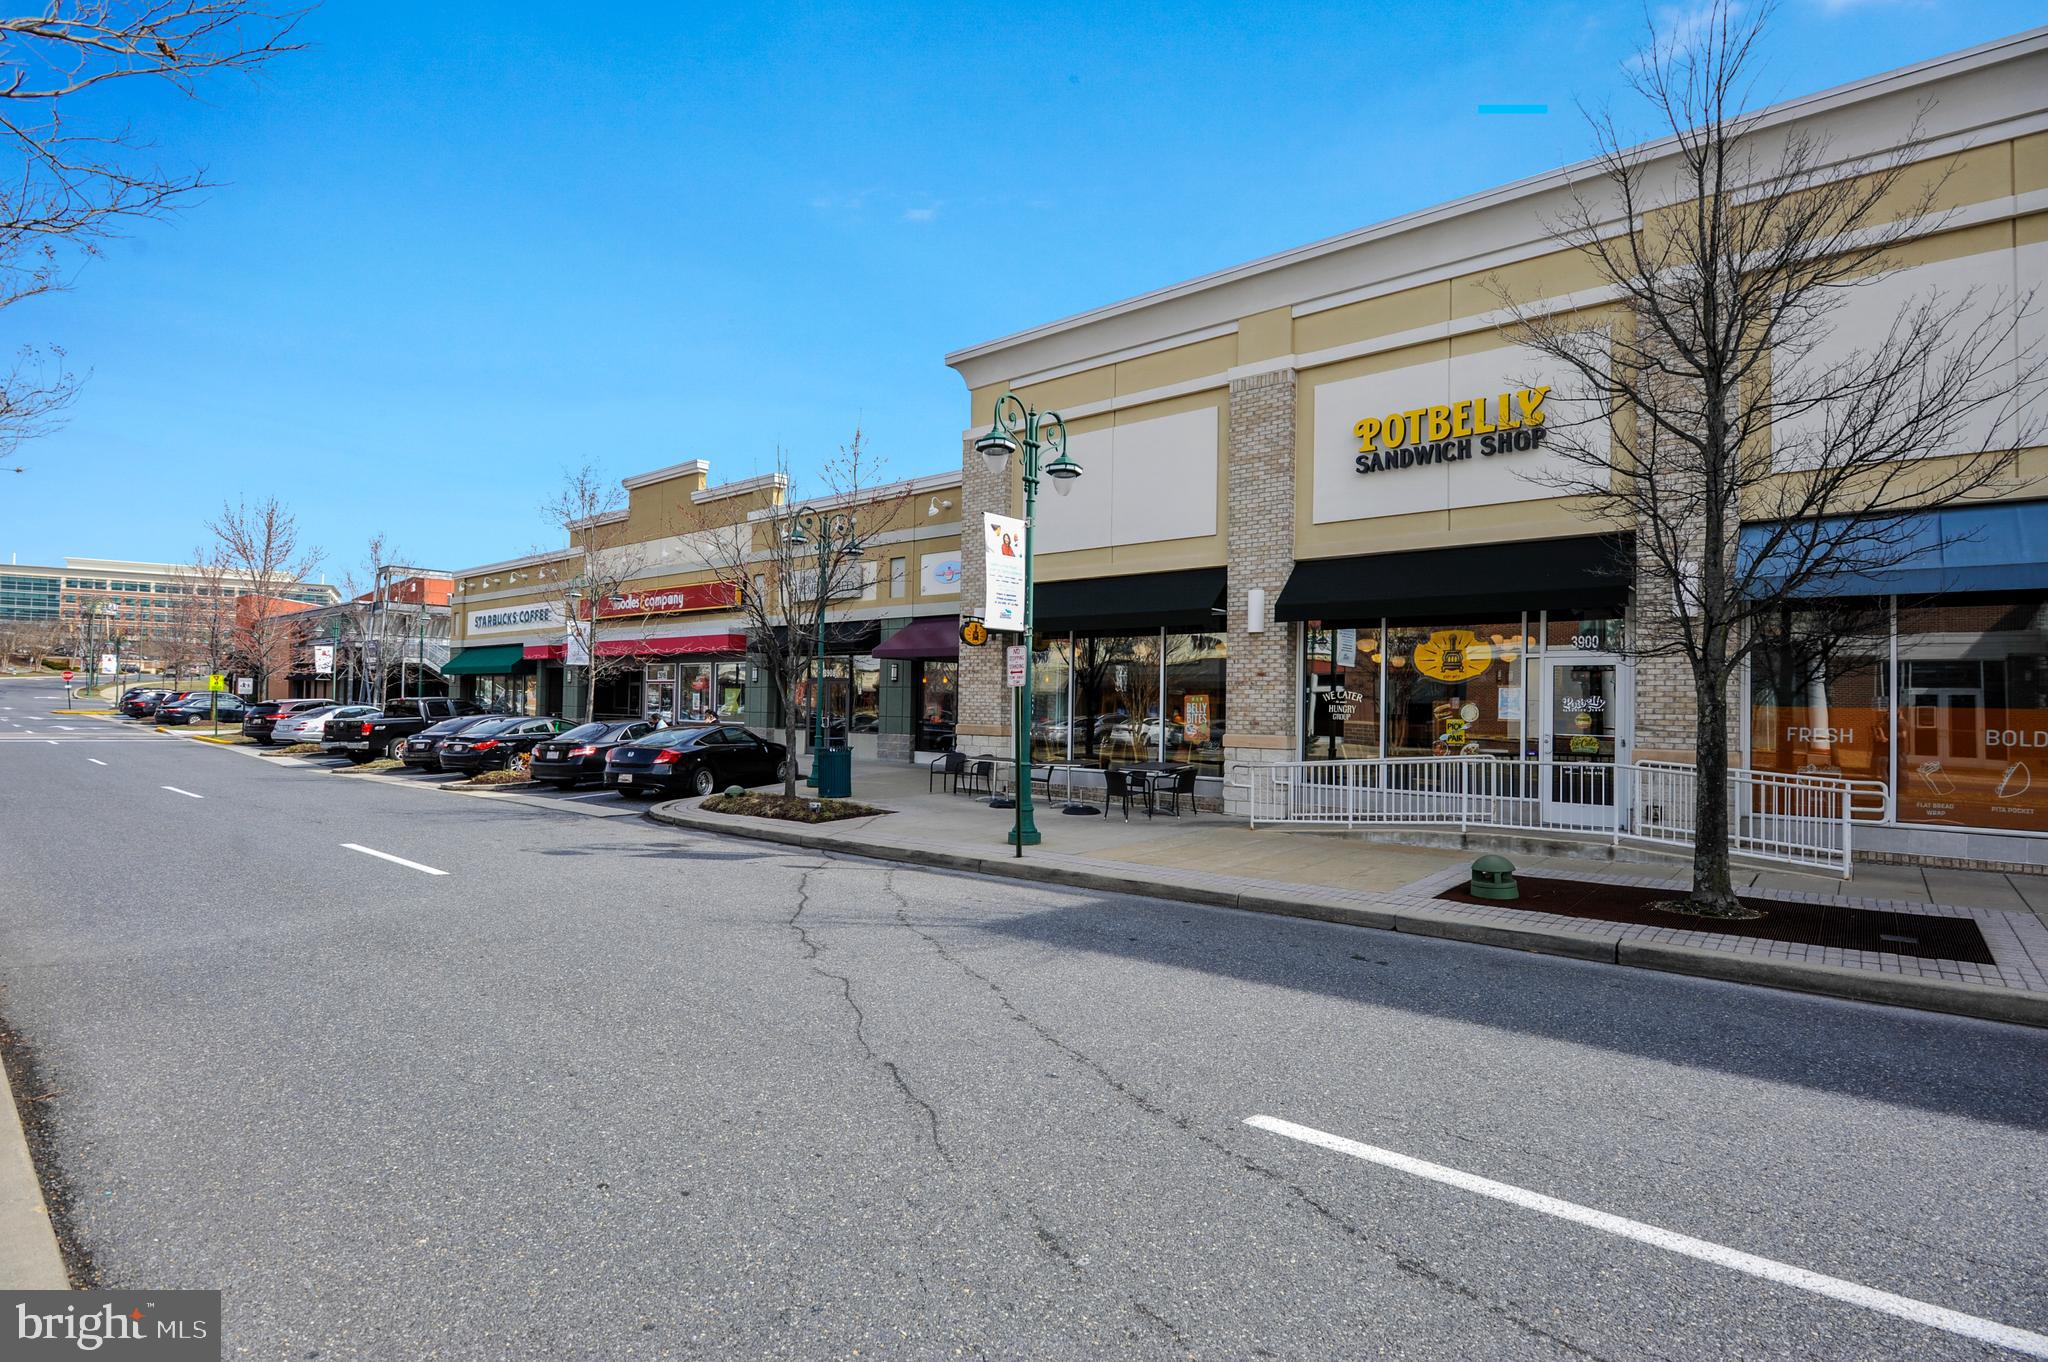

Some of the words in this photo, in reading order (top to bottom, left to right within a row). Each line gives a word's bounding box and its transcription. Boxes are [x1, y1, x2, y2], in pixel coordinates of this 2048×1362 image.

[1353, 385, 1551, 452] POTBELLY
[1355, 438, 1473, 474] SANDWICH
[1480, 427, 1548, 457] SHOP
[644, 591, 684, 610] company
[474, 612, 518, 629] STARBUCKS
[519, 608, 550, 624] COFFEE
[1571, 635, 1600, 649] 3900
[1336, 690, 1364, 703] CATER
[1186, 702, 1208, 714] BELLY
[1328, 704, 1357, 714] HUNGRY
[1186, 713, 1208, 724] BITES
[1332, 713, 1352, 721] GROUP
[1447, 722, 1463, 731] PICK
[1447, 734, 1463, 742] PAIR
[1786, 726, 1853, 744] FRESH
[1985, 729, 2048, 748] BOLD
